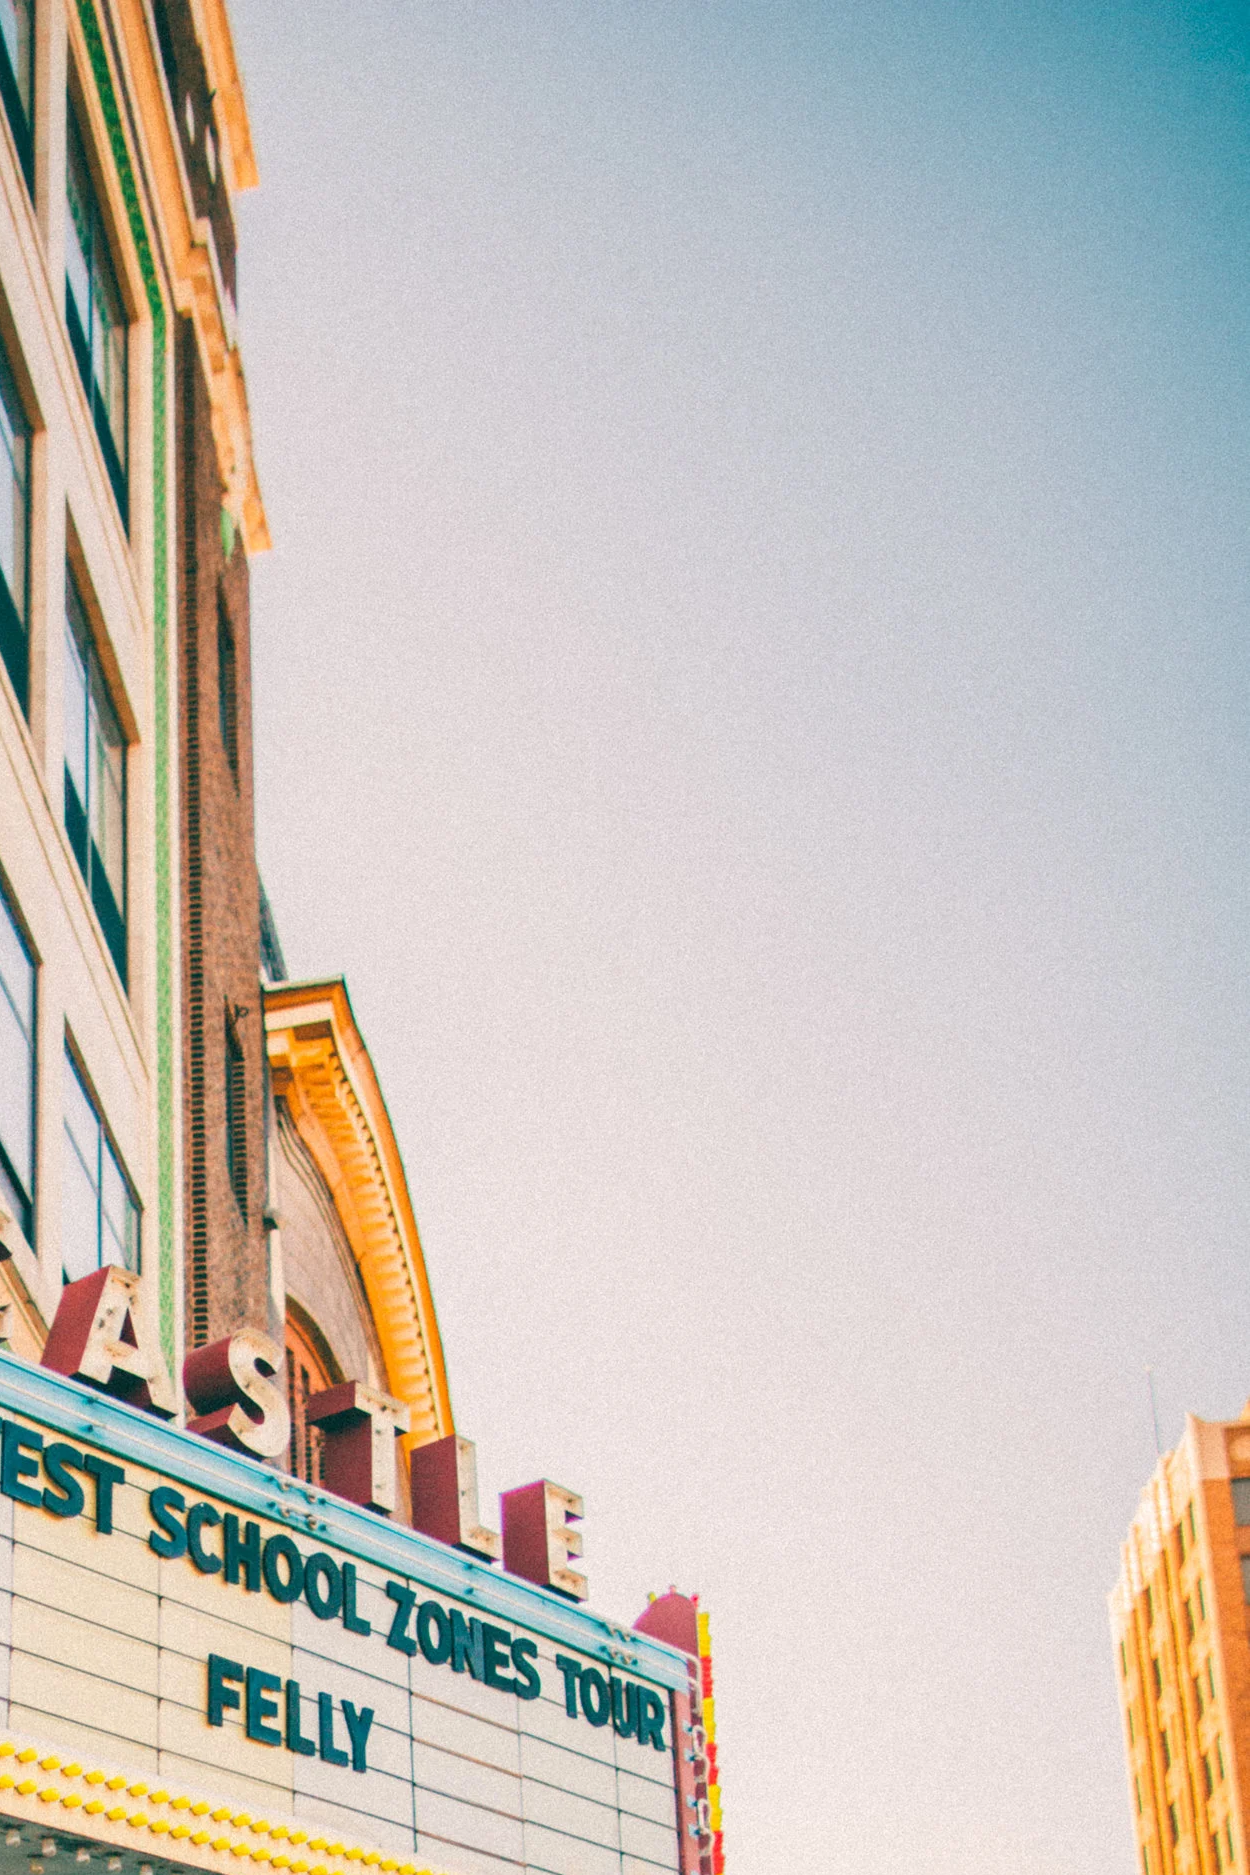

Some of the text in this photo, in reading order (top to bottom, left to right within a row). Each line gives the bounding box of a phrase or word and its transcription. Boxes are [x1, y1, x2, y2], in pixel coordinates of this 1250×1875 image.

[149, 1485, 371, 1637] SCHOOL
[386, 1579, 541, 1701] ZONES
[556, 1652, 667, 1752] TOUR
[206, 1652, 375, 1773] FELLY
